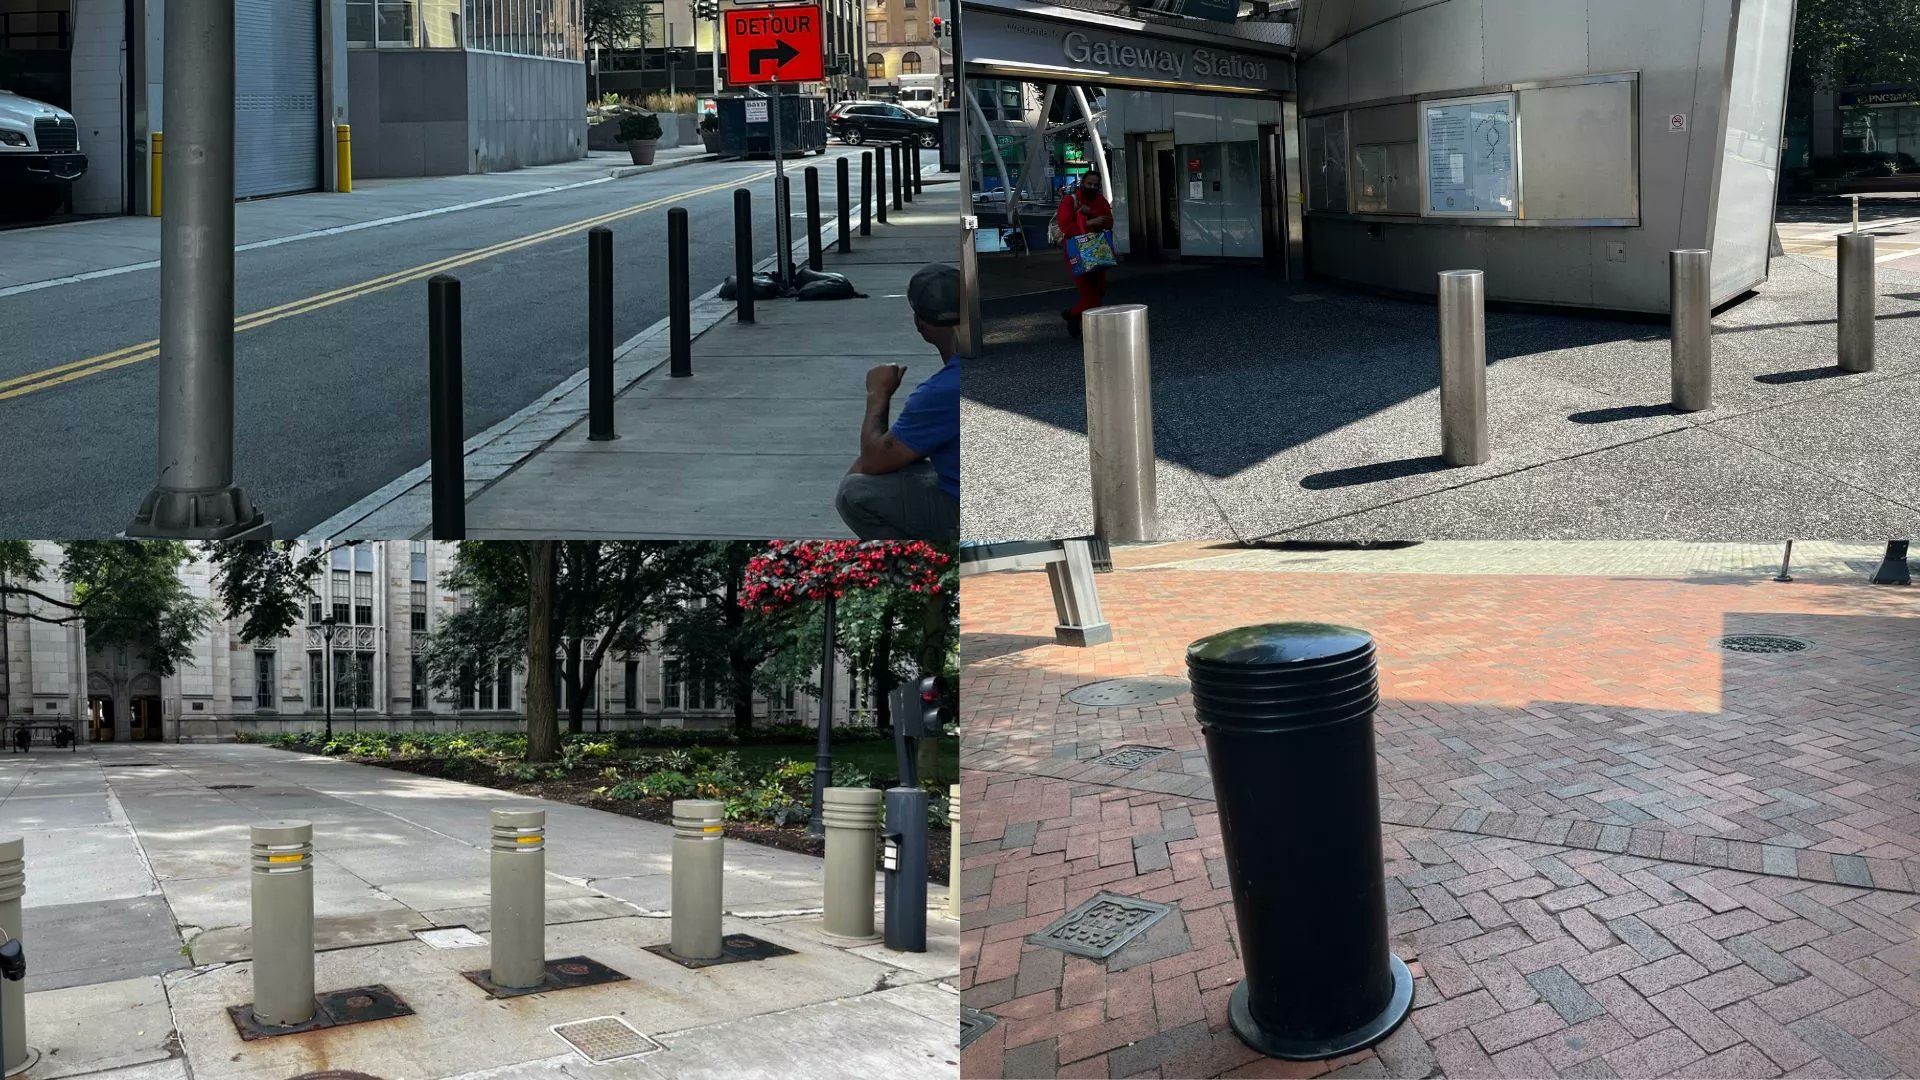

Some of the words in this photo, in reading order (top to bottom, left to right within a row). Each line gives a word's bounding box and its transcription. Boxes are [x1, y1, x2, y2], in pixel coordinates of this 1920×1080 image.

[736, 16, 810, 35] DETOUR
[1064, 31, 1186, 78] Gateway
[1193, 48, 1268, 81] Station
[1869, 94, 1889, 103] PNC
